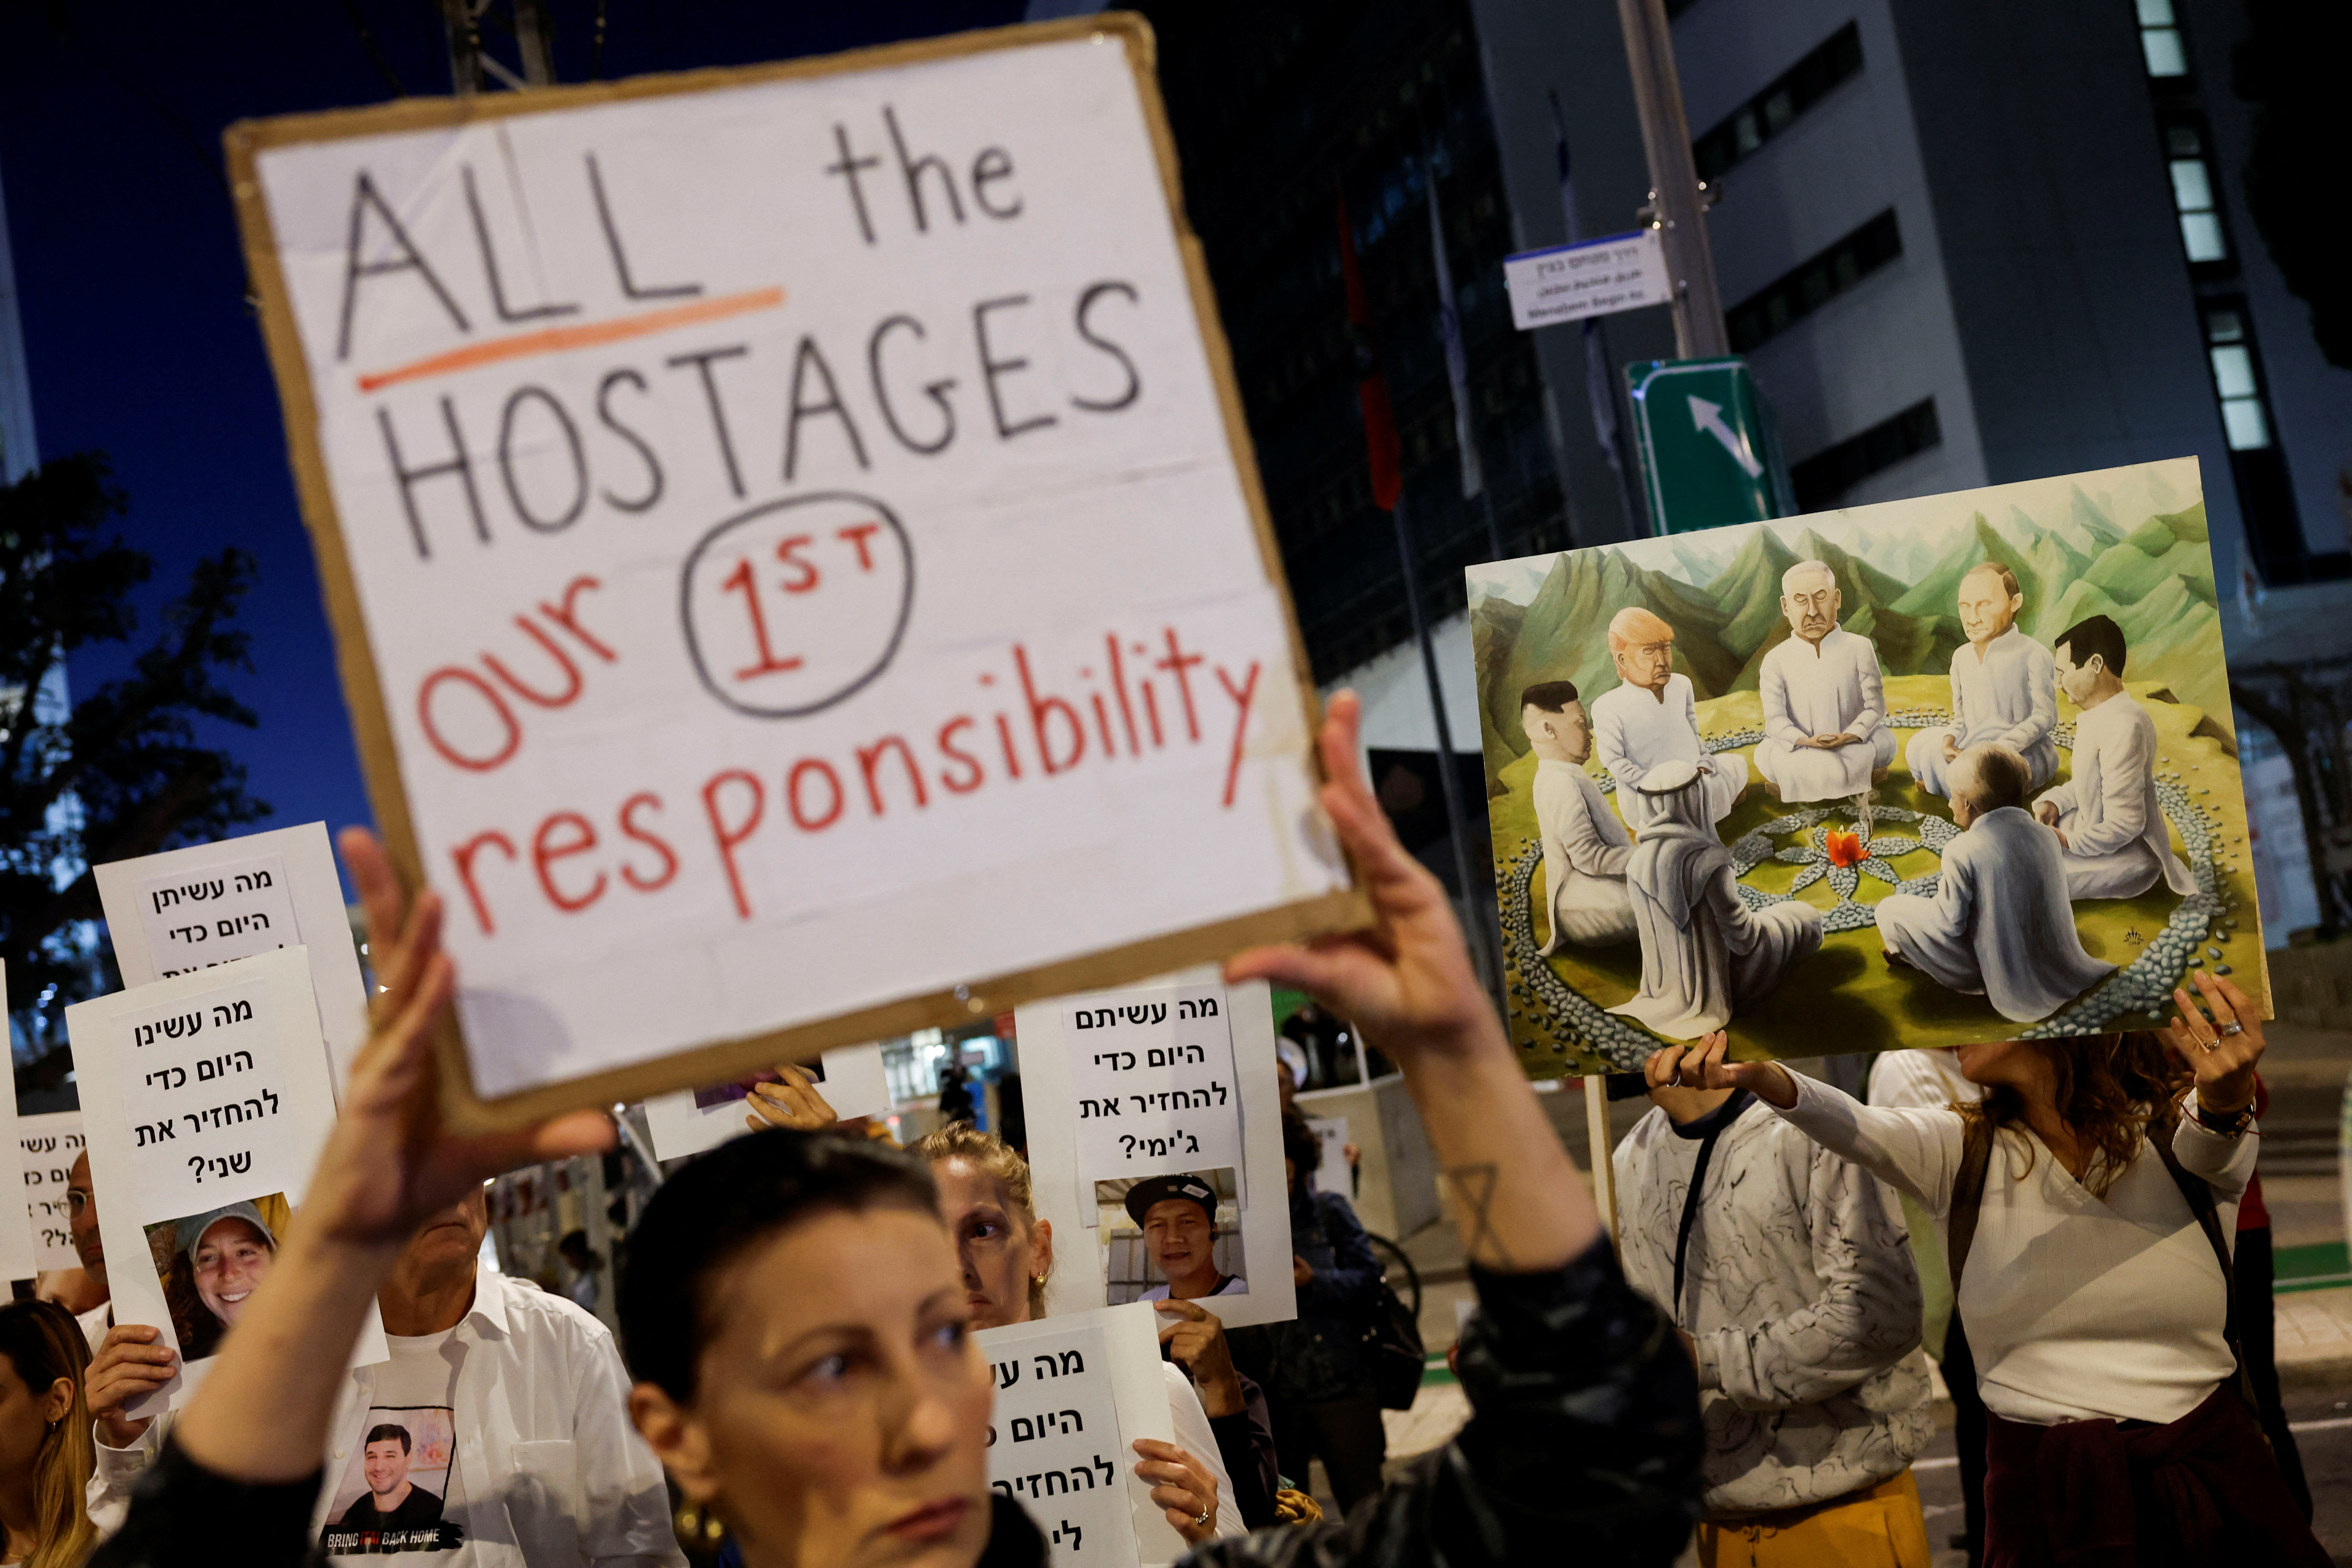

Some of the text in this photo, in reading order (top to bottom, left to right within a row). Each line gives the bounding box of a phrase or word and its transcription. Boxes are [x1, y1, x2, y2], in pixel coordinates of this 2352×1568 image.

[335, 105, 1023, 363] ALL the
[375, 279, 1143, 561] HOSTAGES
[722, 523, 879, 681] 1ST
[450, 626, 1261, 937] responsibility
[153, 871, 272, 914] מה עשיתן
[170, 914, 269, 942] היום כדי
[135, 1001, 252, 1047] מה עשינו
[1076, 998, 1218, 1029] מה עשיתם
[146, 1051, 253, 1090] היום כדי
[1094, 1045, 1204, 1071] היום כדי
[1080, 1082, 1226, 1118] להחזיר את
[135, 1089, 278, 1147] להחזיר את
[21, 1137, 56, 1152] עשי
[1119, 1130, 1199, 1158] ג'ימי?
[188, 1151, 250, 1183] שני?
[1034, 1350, 1084, 1379] מה
[1011, 1410, 1083, 1442] היום
[992, 1455, 1114, 1499] להחזיר
[328, 1533, 358, 1547] BRING
[382, 1530, 408, 1545] BACK
[410, 1528, 440, 1543] HOME
[1053, 1520, 1081, 1550] לי
